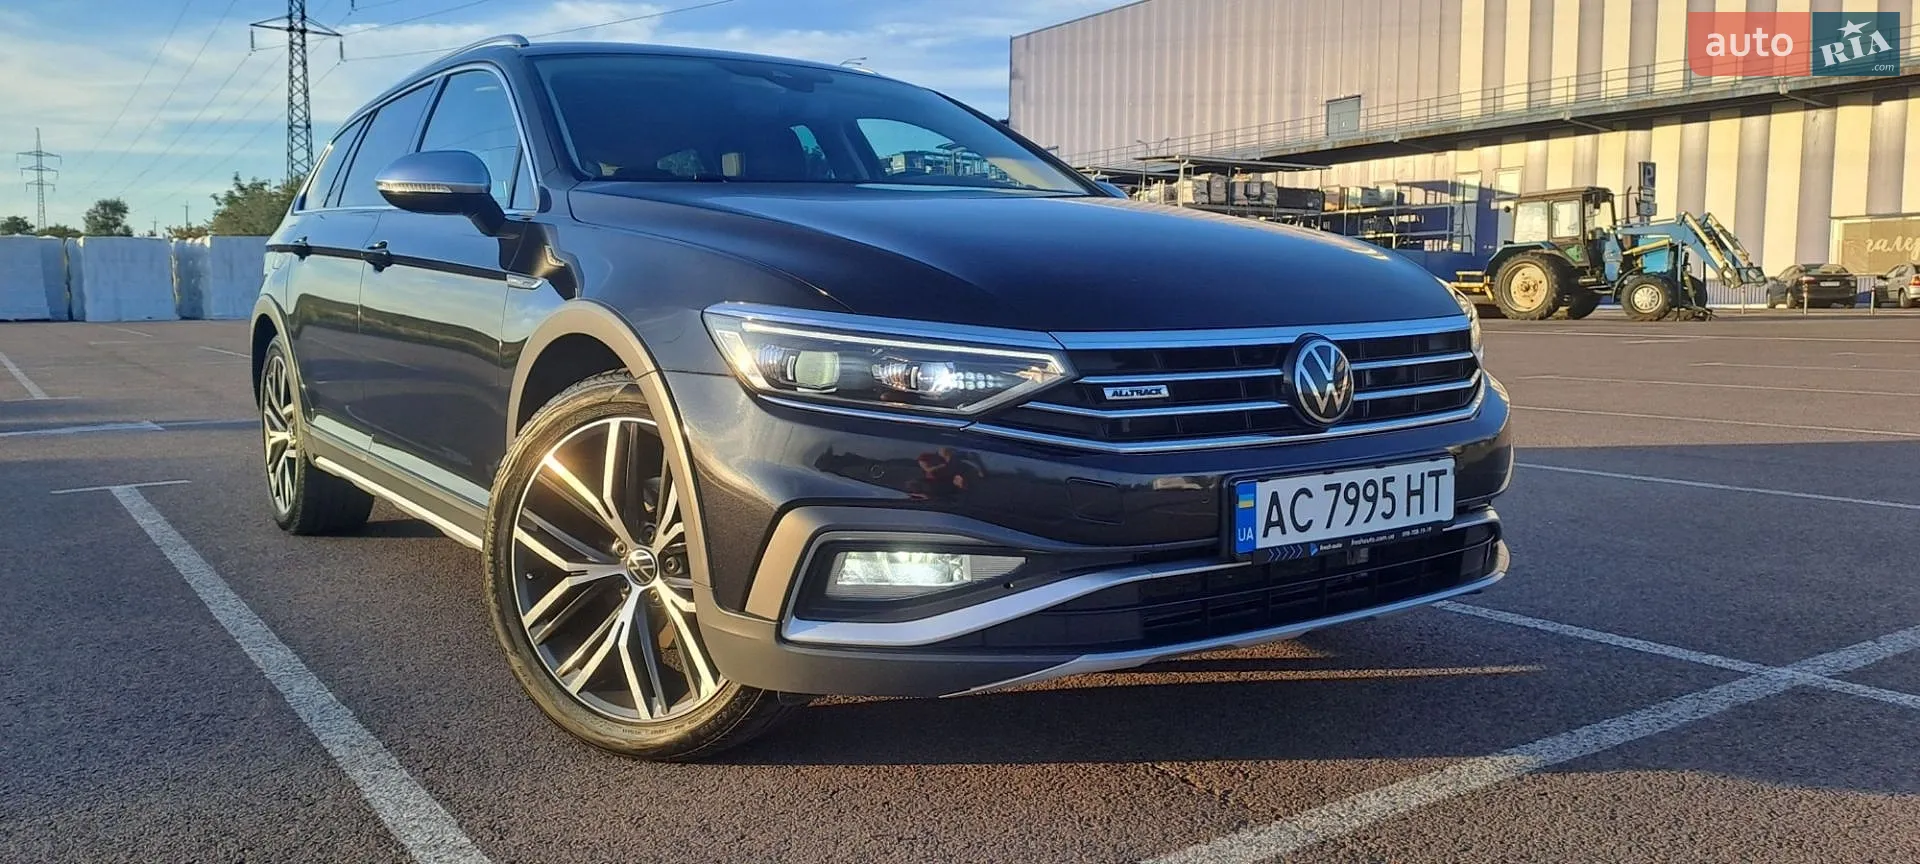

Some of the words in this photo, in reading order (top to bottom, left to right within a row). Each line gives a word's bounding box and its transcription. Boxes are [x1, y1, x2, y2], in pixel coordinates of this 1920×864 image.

[1262, 487, 1314, 538] AC
[1324, 476, 1396, 529] 7995
[1406, 469, 1448, 517] HT
[1238, 526, 1254, 542] UA
